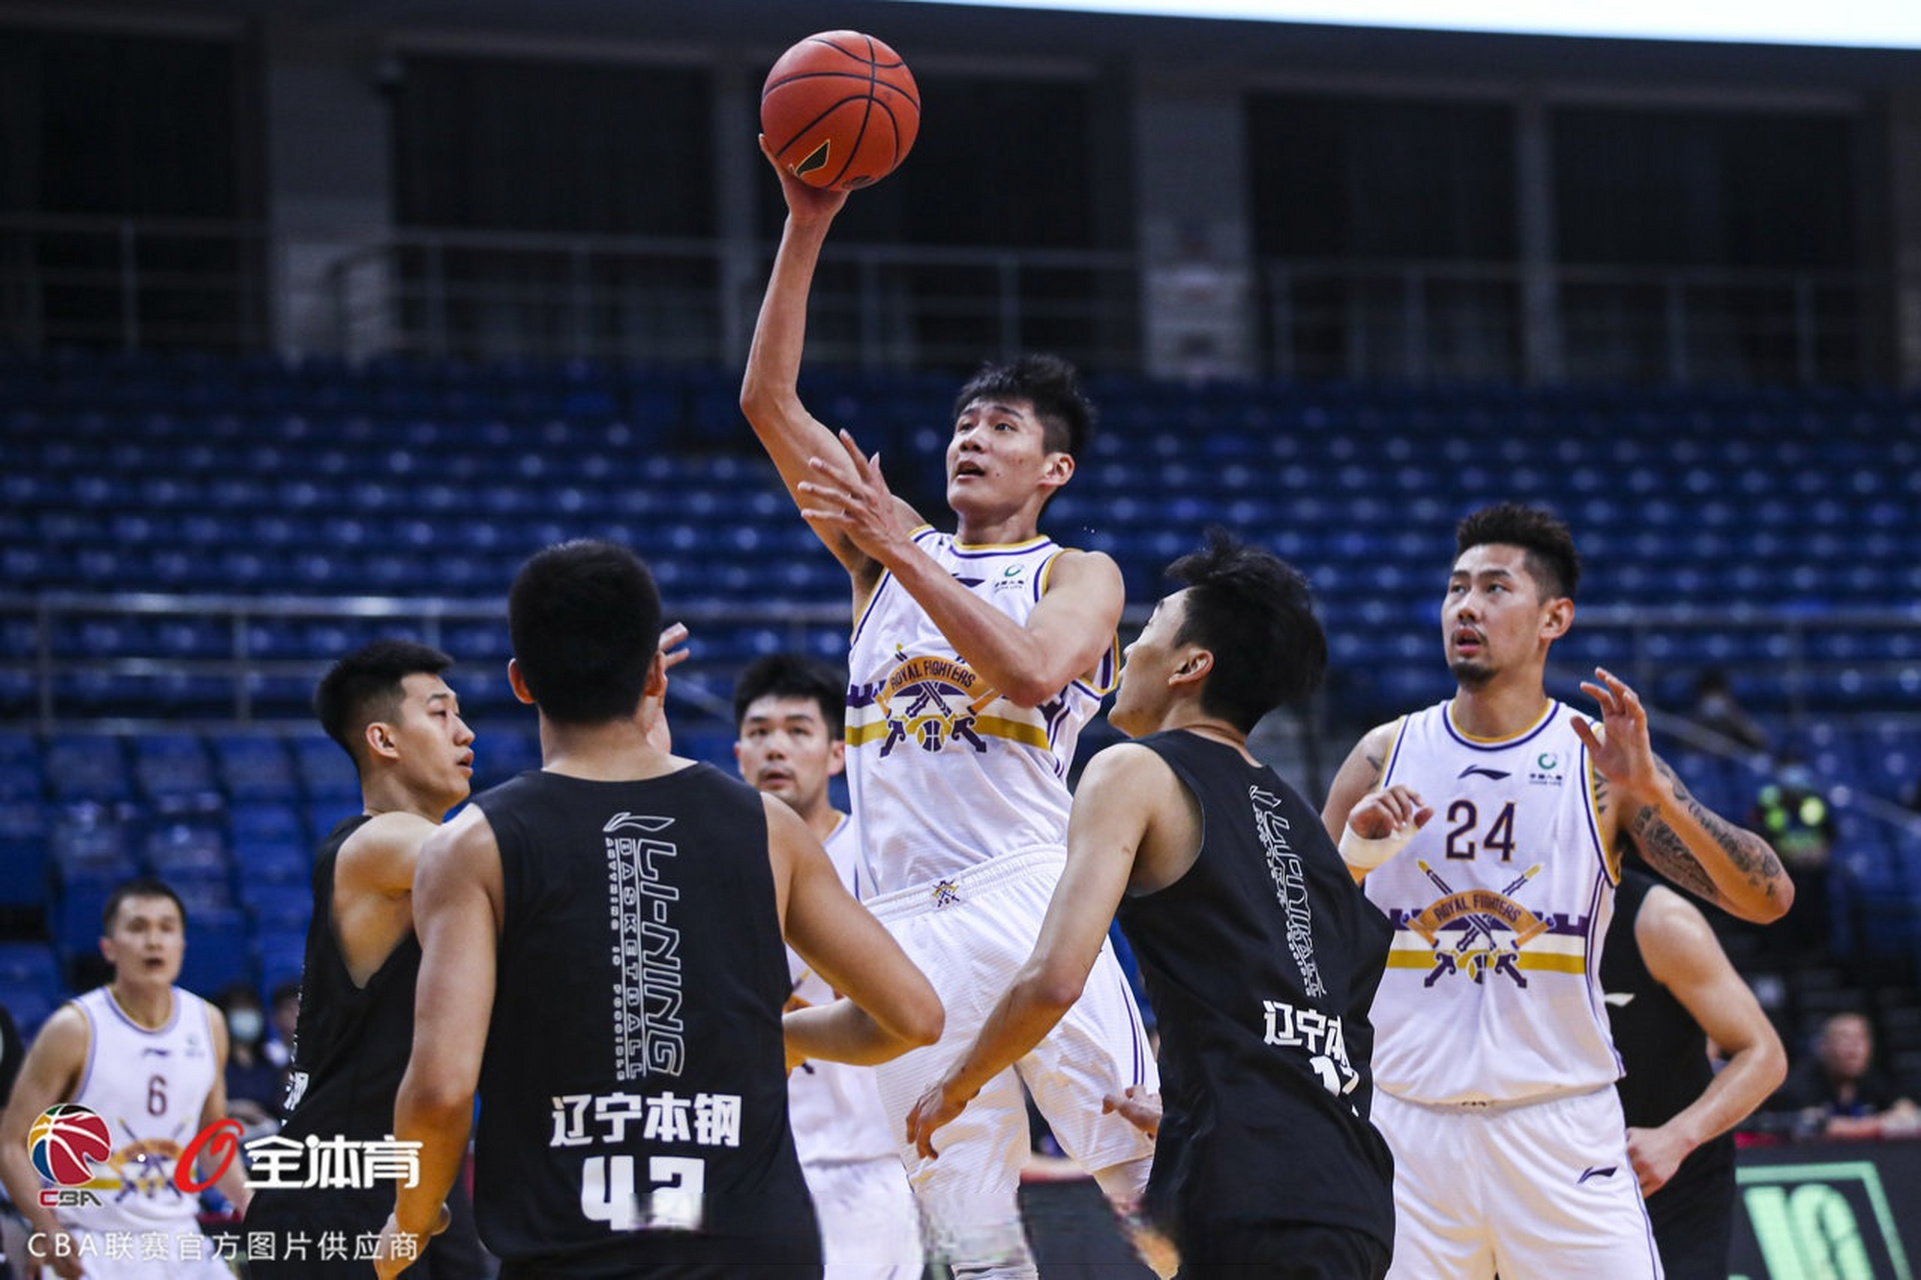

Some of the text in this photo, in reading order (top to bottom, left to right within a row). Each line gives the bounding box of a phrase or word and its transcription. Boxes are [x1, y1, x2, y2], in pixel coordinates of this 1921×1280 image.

[891, 660, 976, 690] ROYAL FIGHTERS
[1446, 800, 1516, 862] 24
[1433, 896, 1469, 921] ROYAL
[619, 838, 643, 1080] BASKETBALL
[638, 838, 686, 1077] LI-NING
[1263, 1000, 1350, 1074] 辽宁本
[147, 1075, 168, 1117] 6
[550, 1091, 742, 1148] 辽宁本钢
